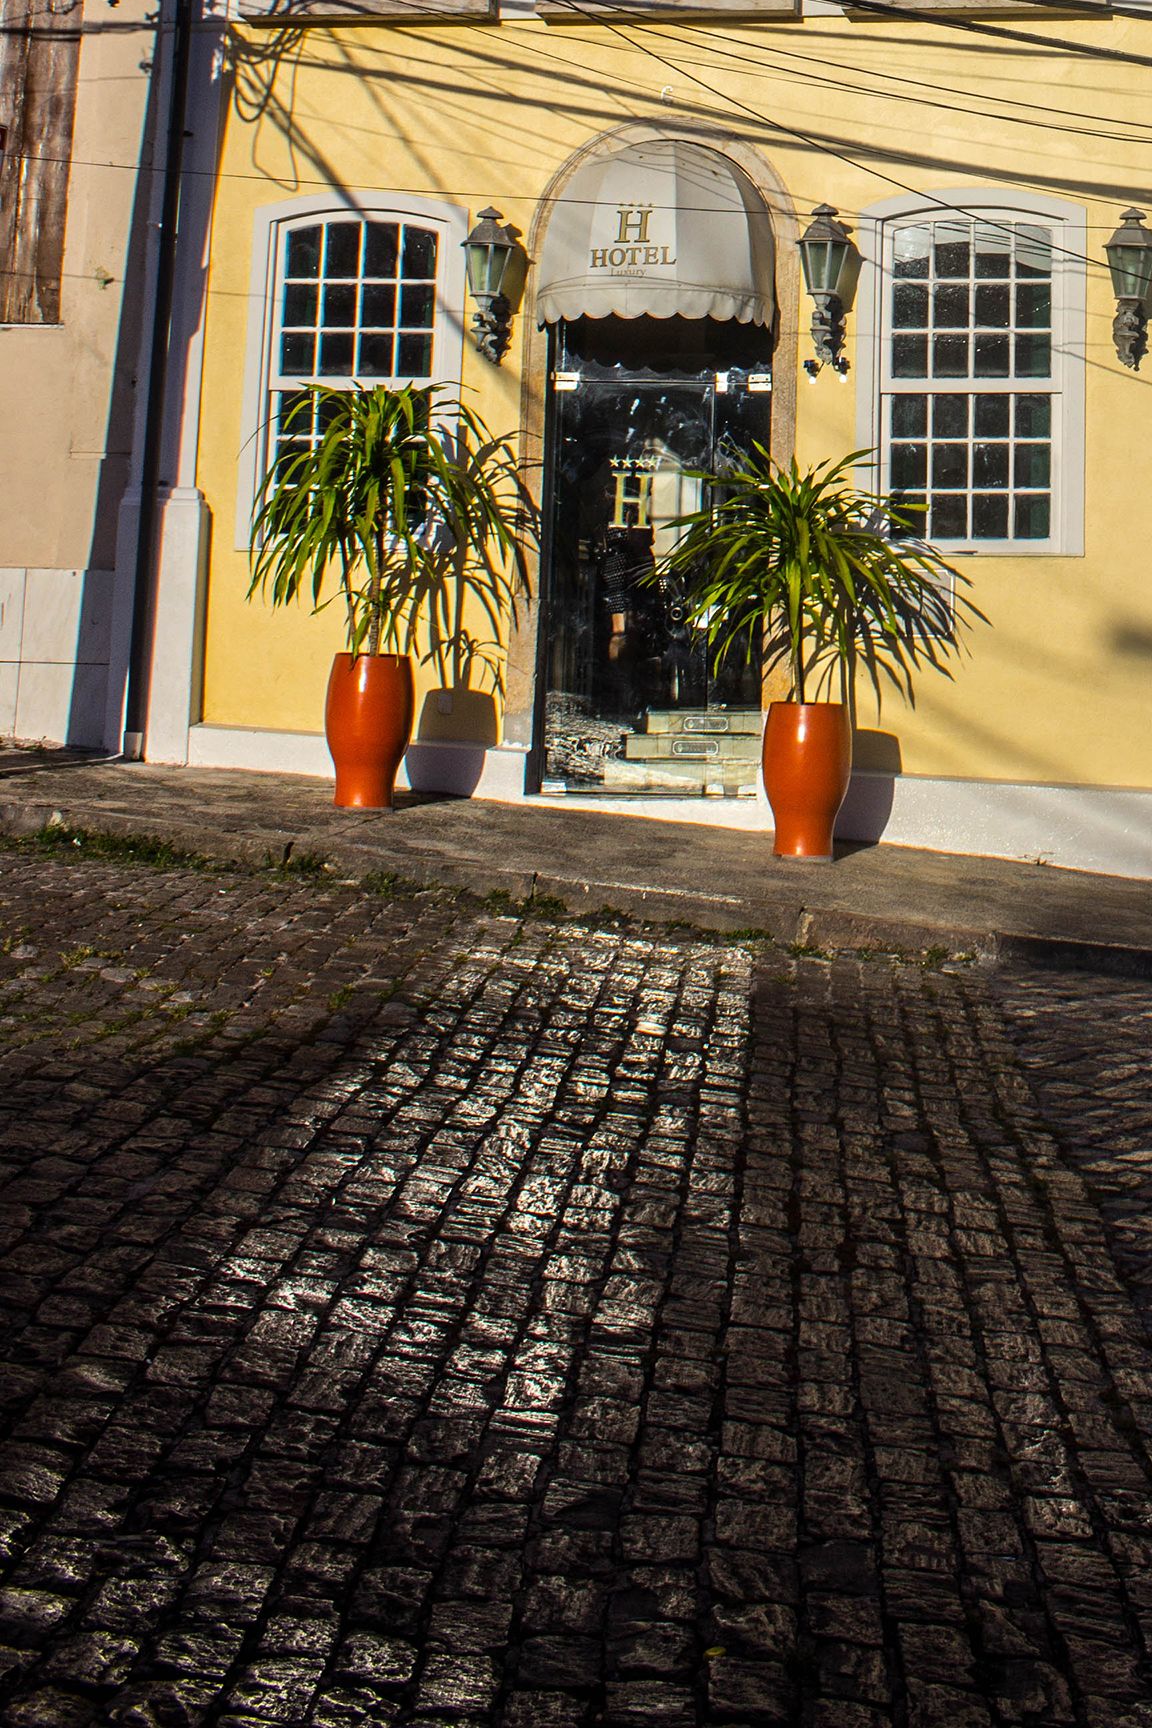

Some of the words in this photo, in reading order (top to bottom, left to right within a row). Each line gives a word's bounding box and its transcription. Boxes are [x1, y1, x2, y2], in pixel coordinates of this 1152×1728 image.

[614, 210, 653, 243] H
[590, 246, 677, 268] HOTEL
[608, 471, 653, 529] H
